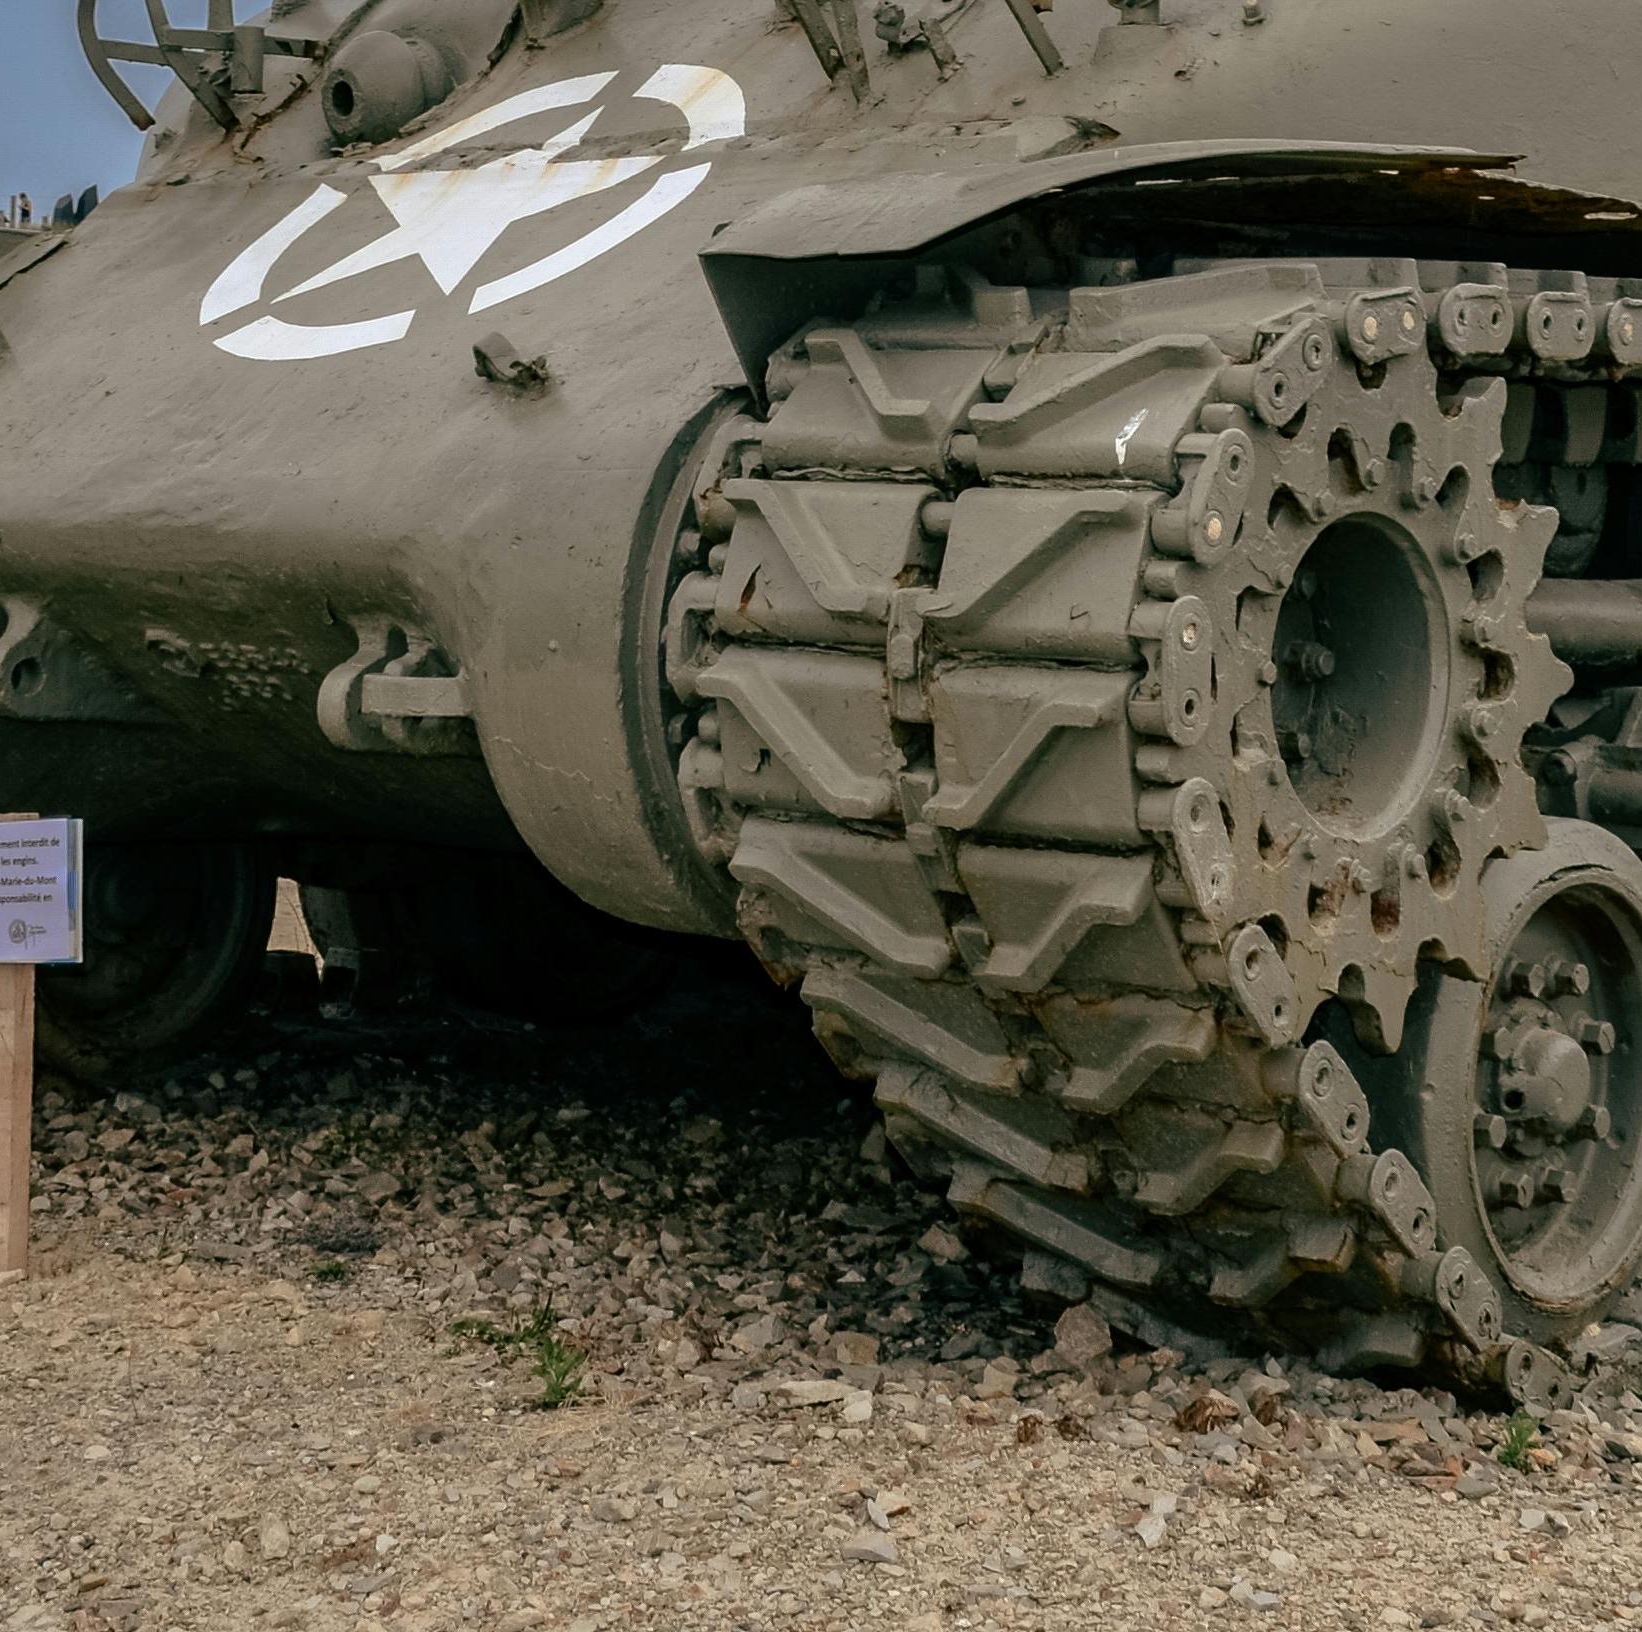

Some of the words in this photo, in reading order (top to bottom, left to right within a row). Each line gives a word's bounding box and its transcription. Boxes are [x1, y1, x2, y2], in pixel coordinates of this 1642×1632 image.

[21, 837, 49, 848] interdit
[50, 837, 60, 847] de
[0, 856, 11, 866] les
[13, 856, 39, 867] engins.
